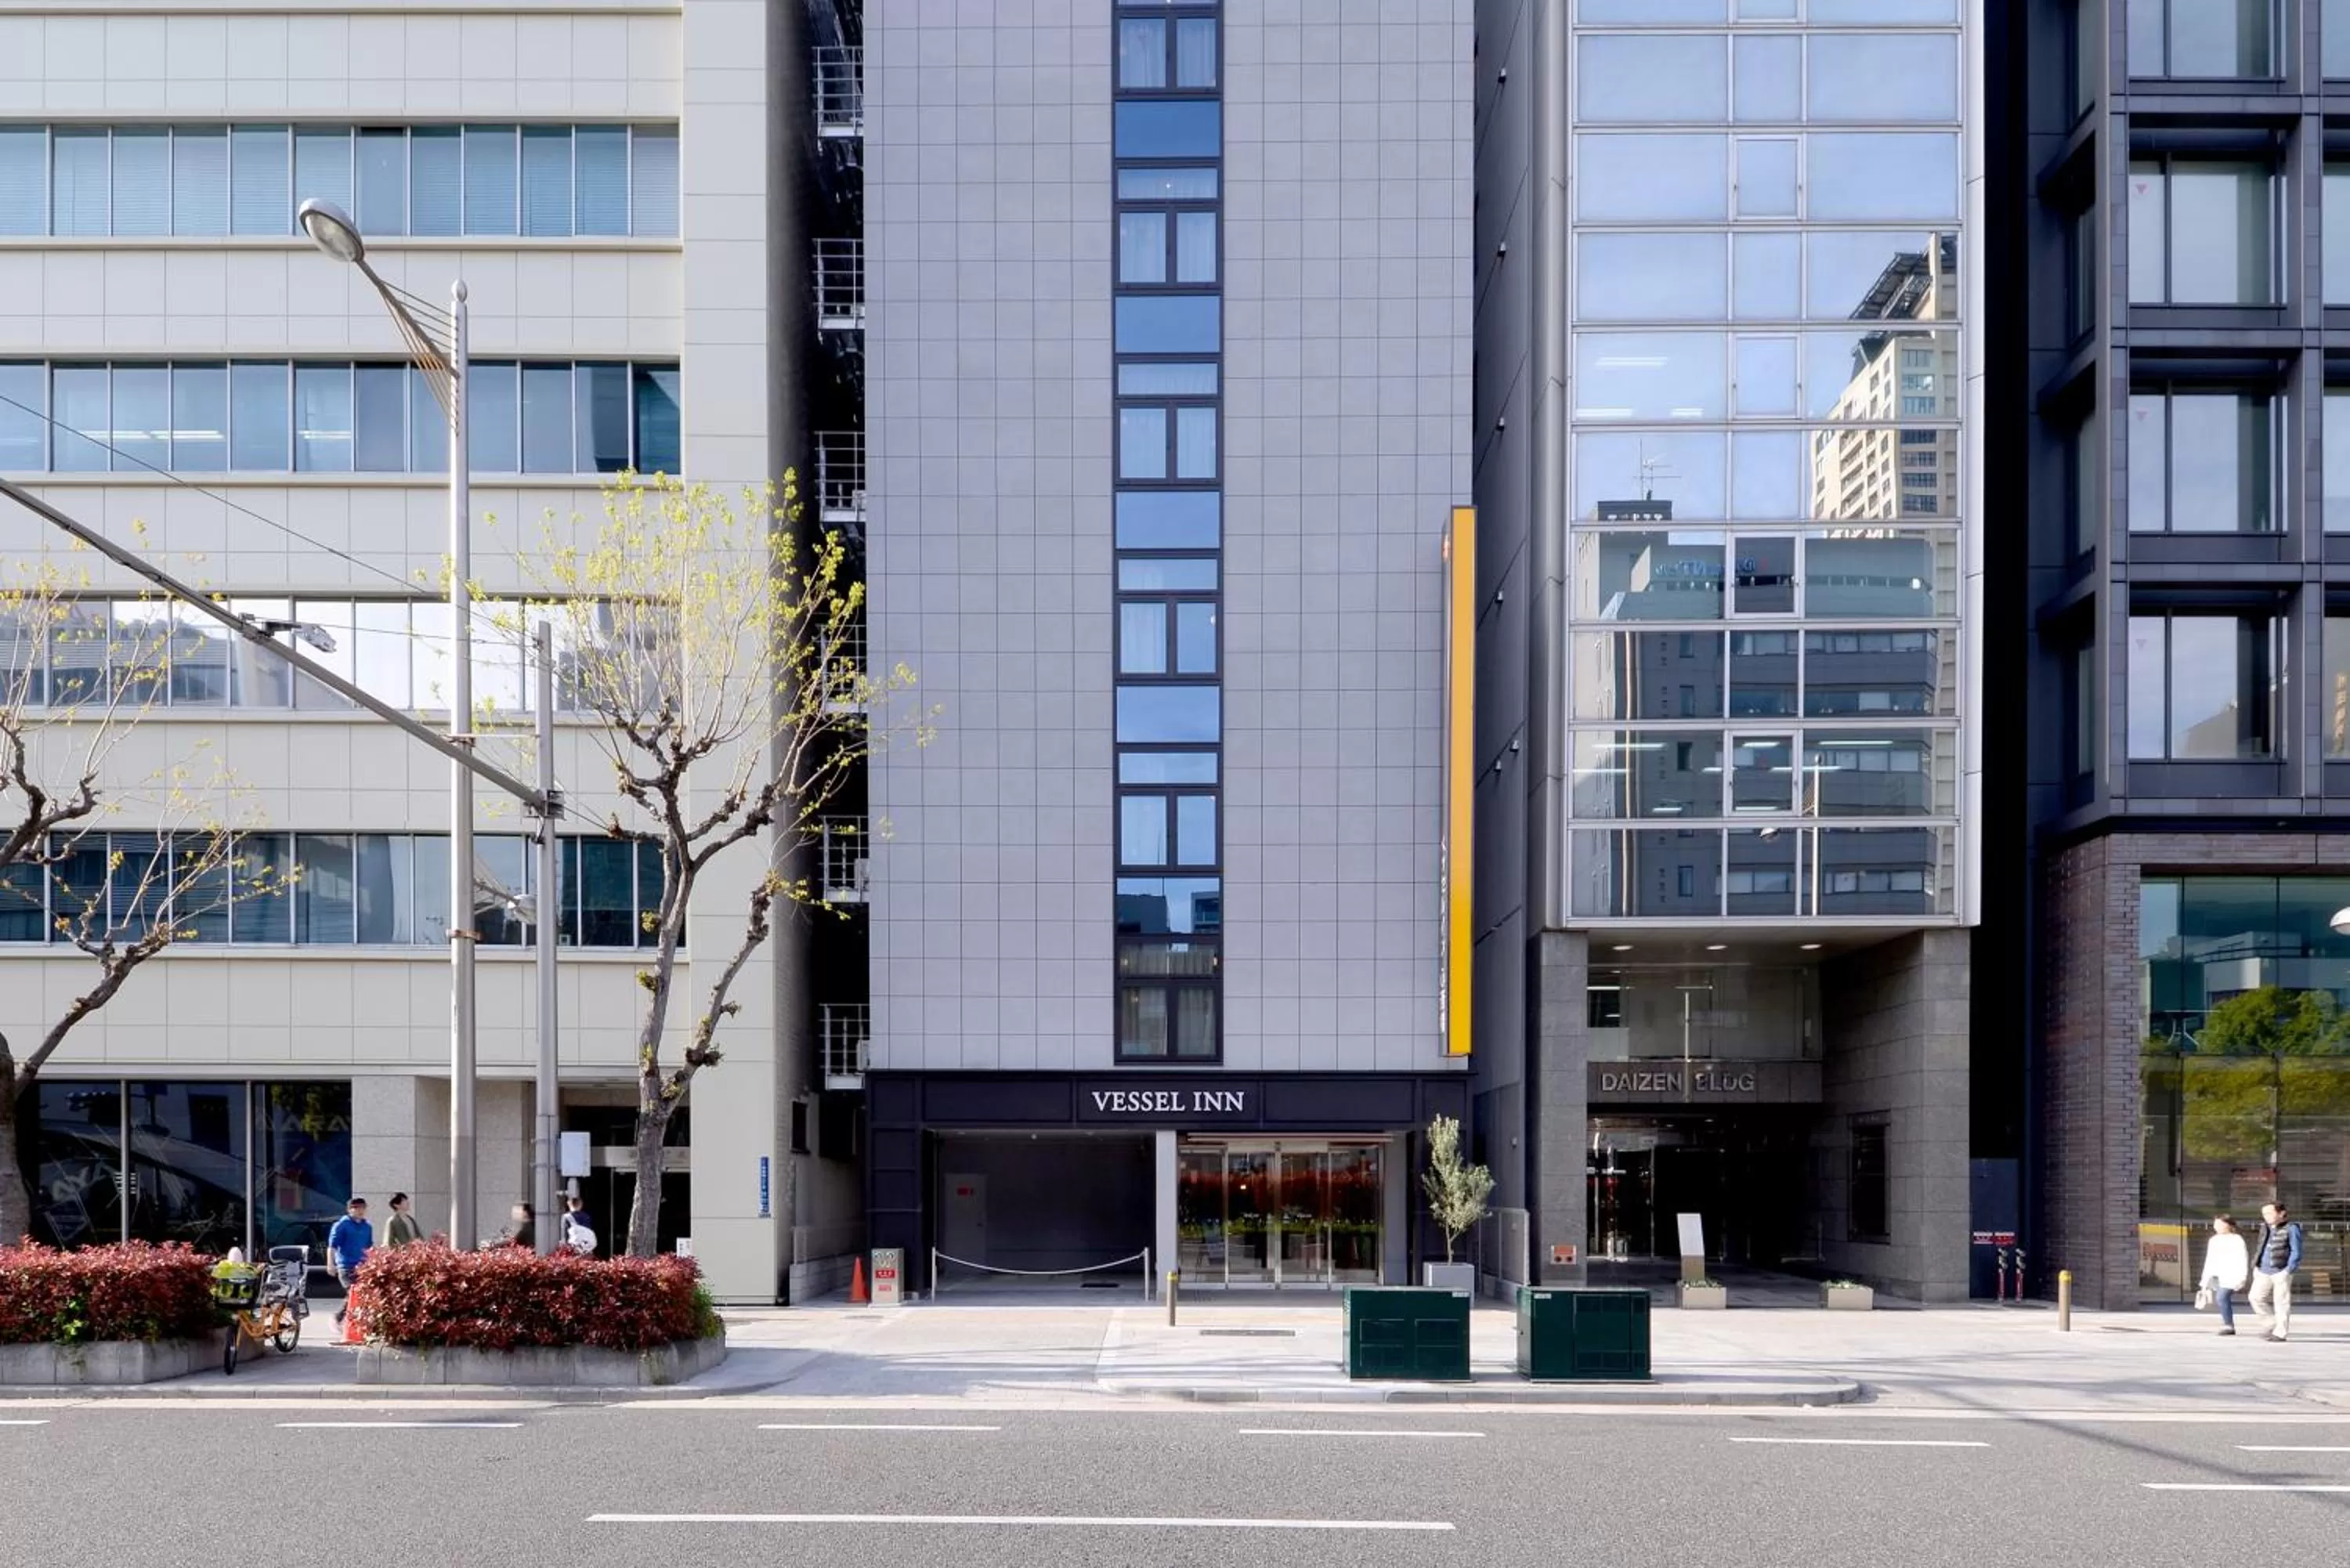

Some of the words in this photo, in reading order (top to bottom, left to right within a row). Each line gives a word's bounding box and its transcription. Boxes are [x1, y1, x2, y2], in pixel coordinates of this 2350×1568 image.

[1601, 1072, 1682, 1091] DAIZEN
[1694, 1072, 1755, 1091] BLDG
[1091, 1090, 1185, 1111] VESSEL
[1192, 1090, 1245, 1111] INN
